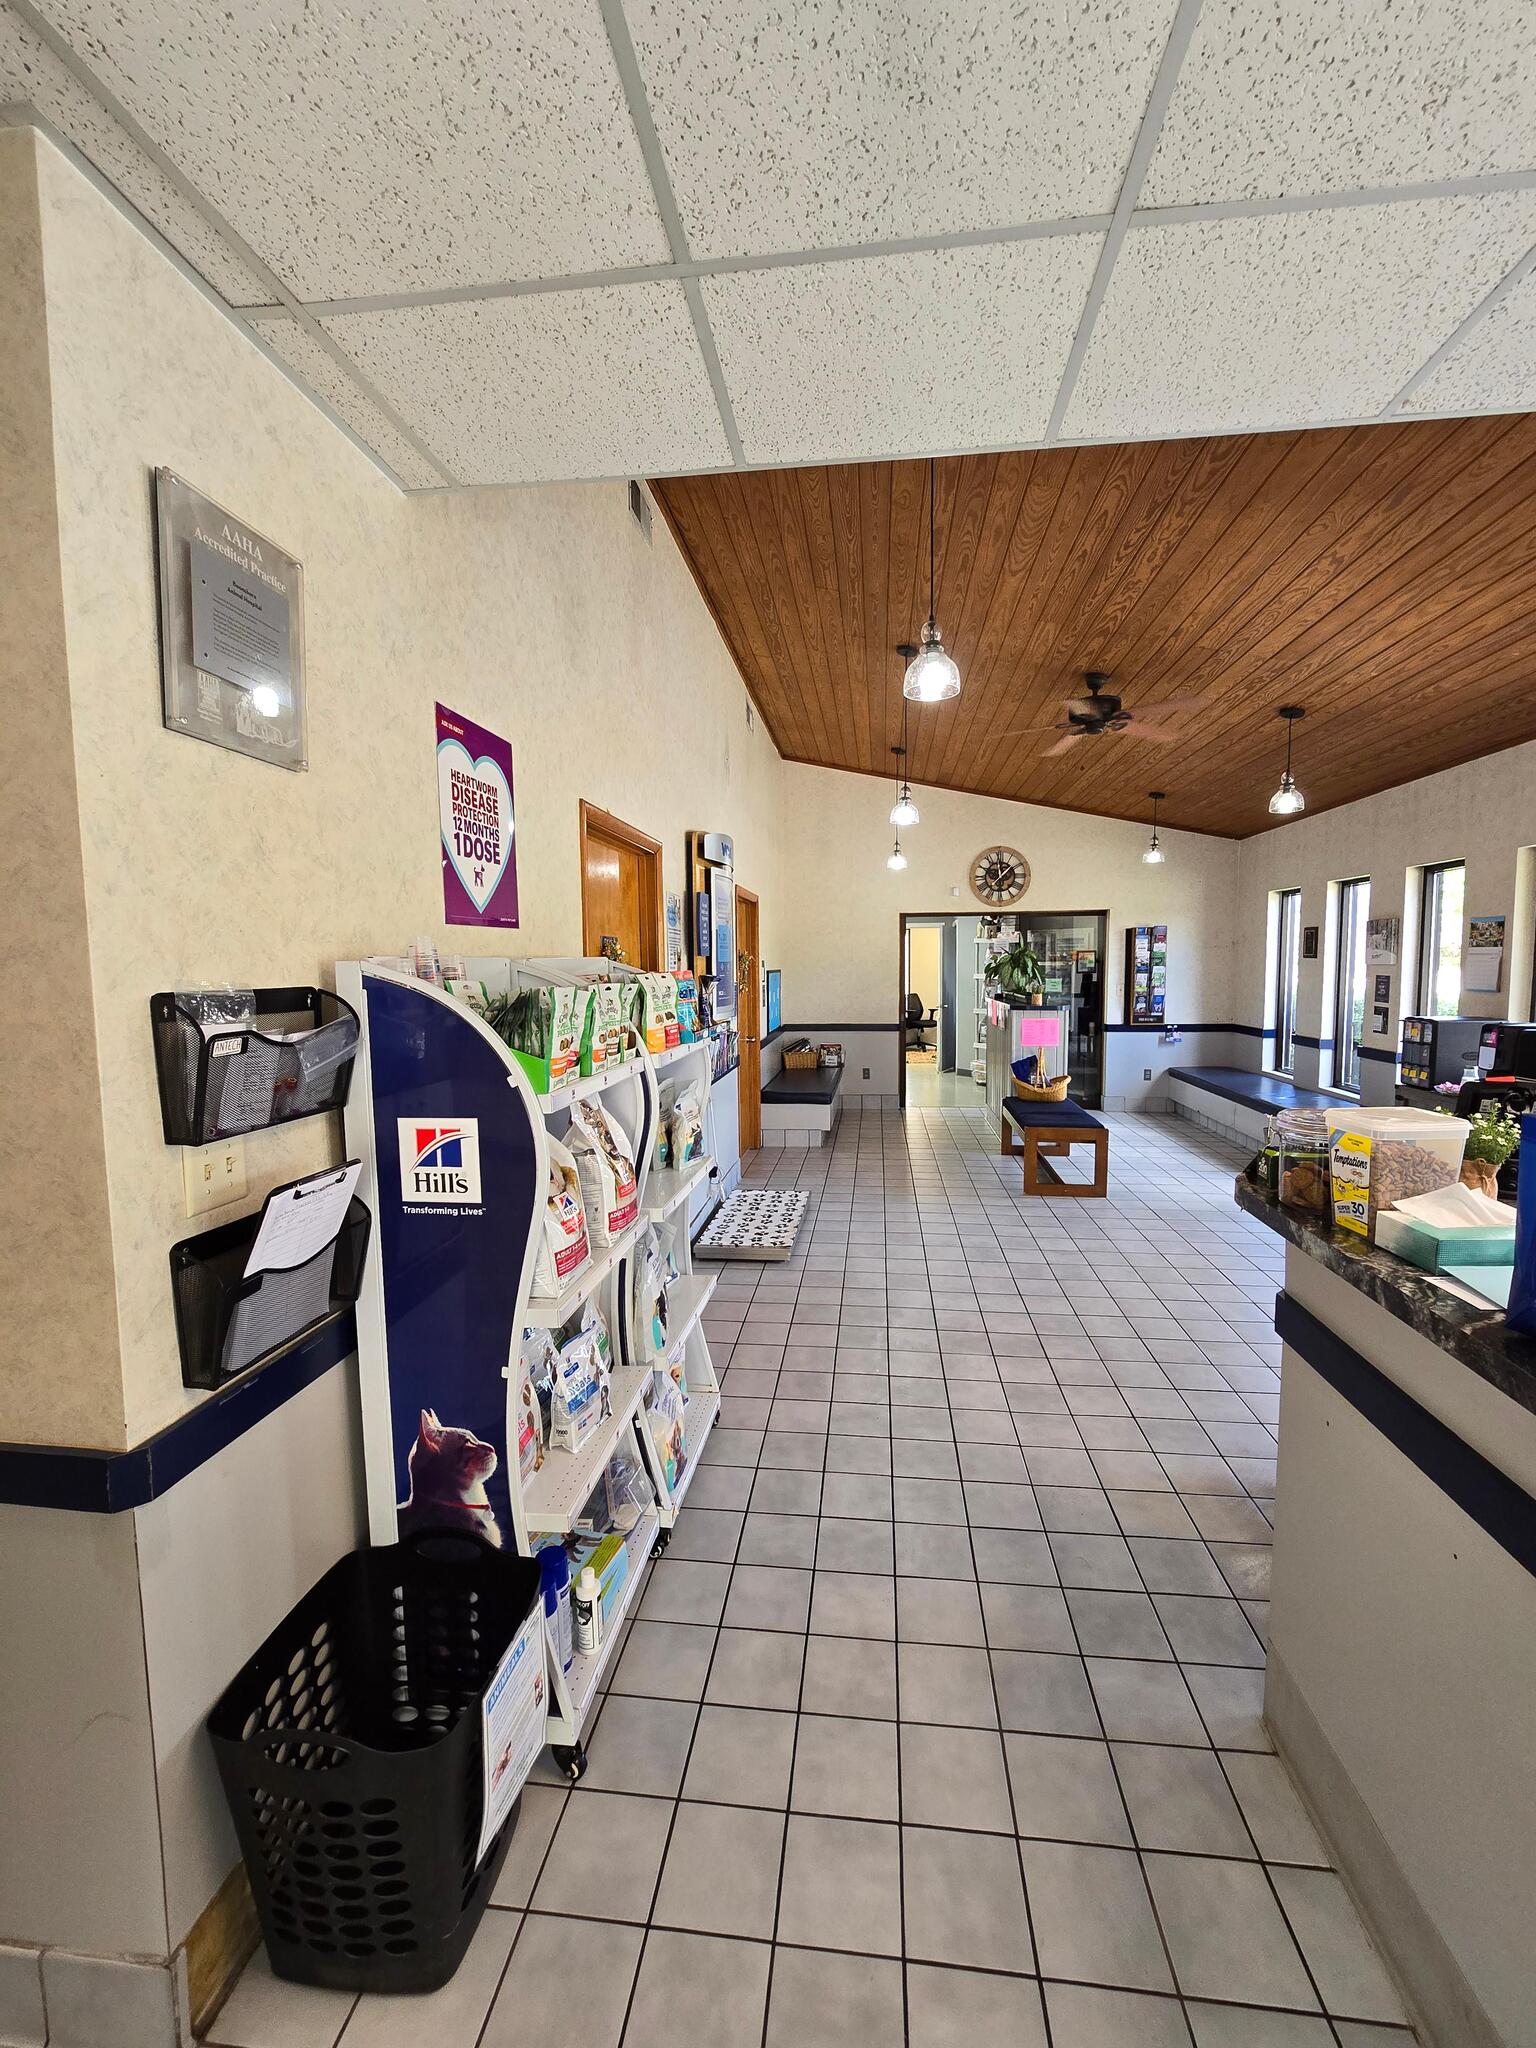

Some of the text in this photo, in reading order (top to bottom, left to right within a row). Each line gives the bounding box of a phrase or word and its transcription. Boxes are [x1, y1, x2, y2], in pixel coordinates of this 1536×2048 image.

[222, 524, 263, 562] AAHA
[194, 527, 248, 569] Accredited
[251, 561, 286, 593] Practice
[450, 768, 498, 798] HEARTWORM
[451, 782, 499, 816] DISEASE
[452, 802, 499, 828] PROTECTION
[453, 816, 500, 842] 12 MONTHS
[454, 832, 501, 865] 1 DOSE
[215, 1040, 240, 1052] ANTECH
[1334, 1148, 1368, 1169] Temptations
[414, 1172, 469, 1194] Hill's
[402, 1206, 458, 1216] Transforming
[1351, 1201, 1365, 1216] 30
